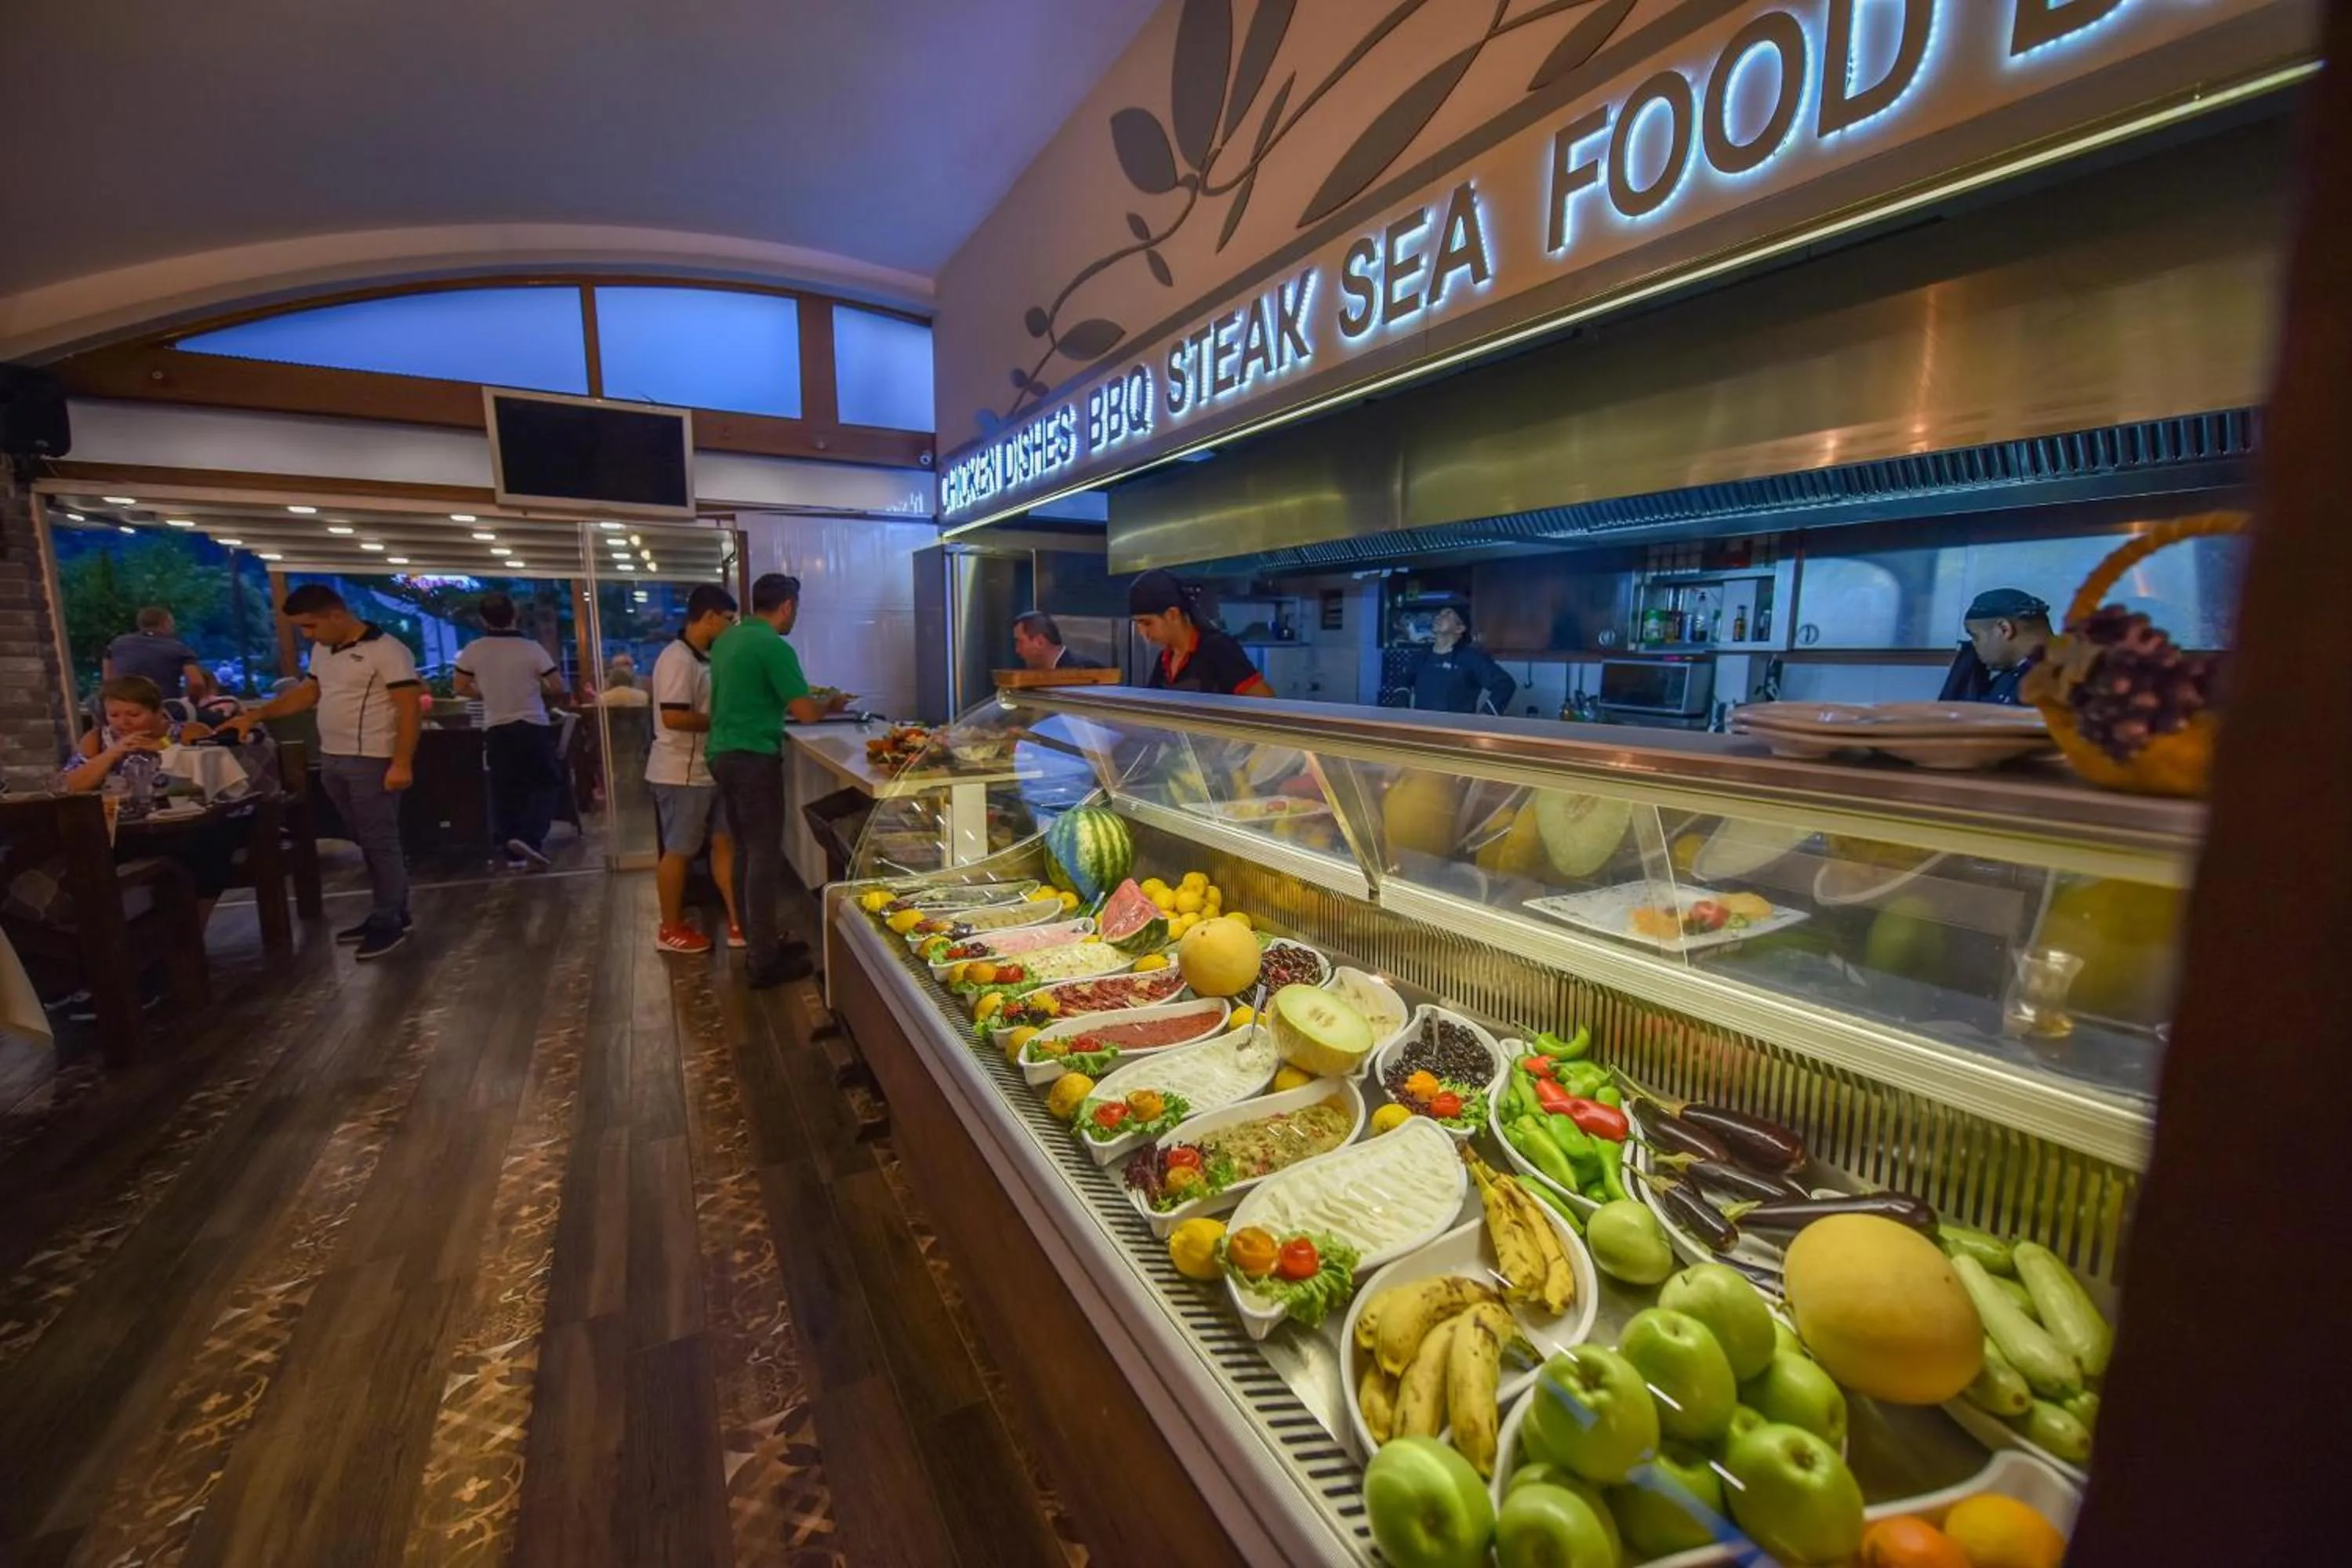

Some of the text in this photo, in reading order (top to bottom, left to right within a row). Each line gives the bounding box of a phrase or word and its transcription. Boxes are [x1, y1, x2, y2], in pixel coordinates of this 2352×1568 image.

[940, 447, 1003, 514] CHICKEN
[1004, 404, 1076, 488] DISHES
[1088, 365, 1153, 452] BBQ
[1167, 267, 1318, 416] STEAK
[1338, 180, 1491, 339] SEA
[1548, 0, 1933, 253] FOOD
